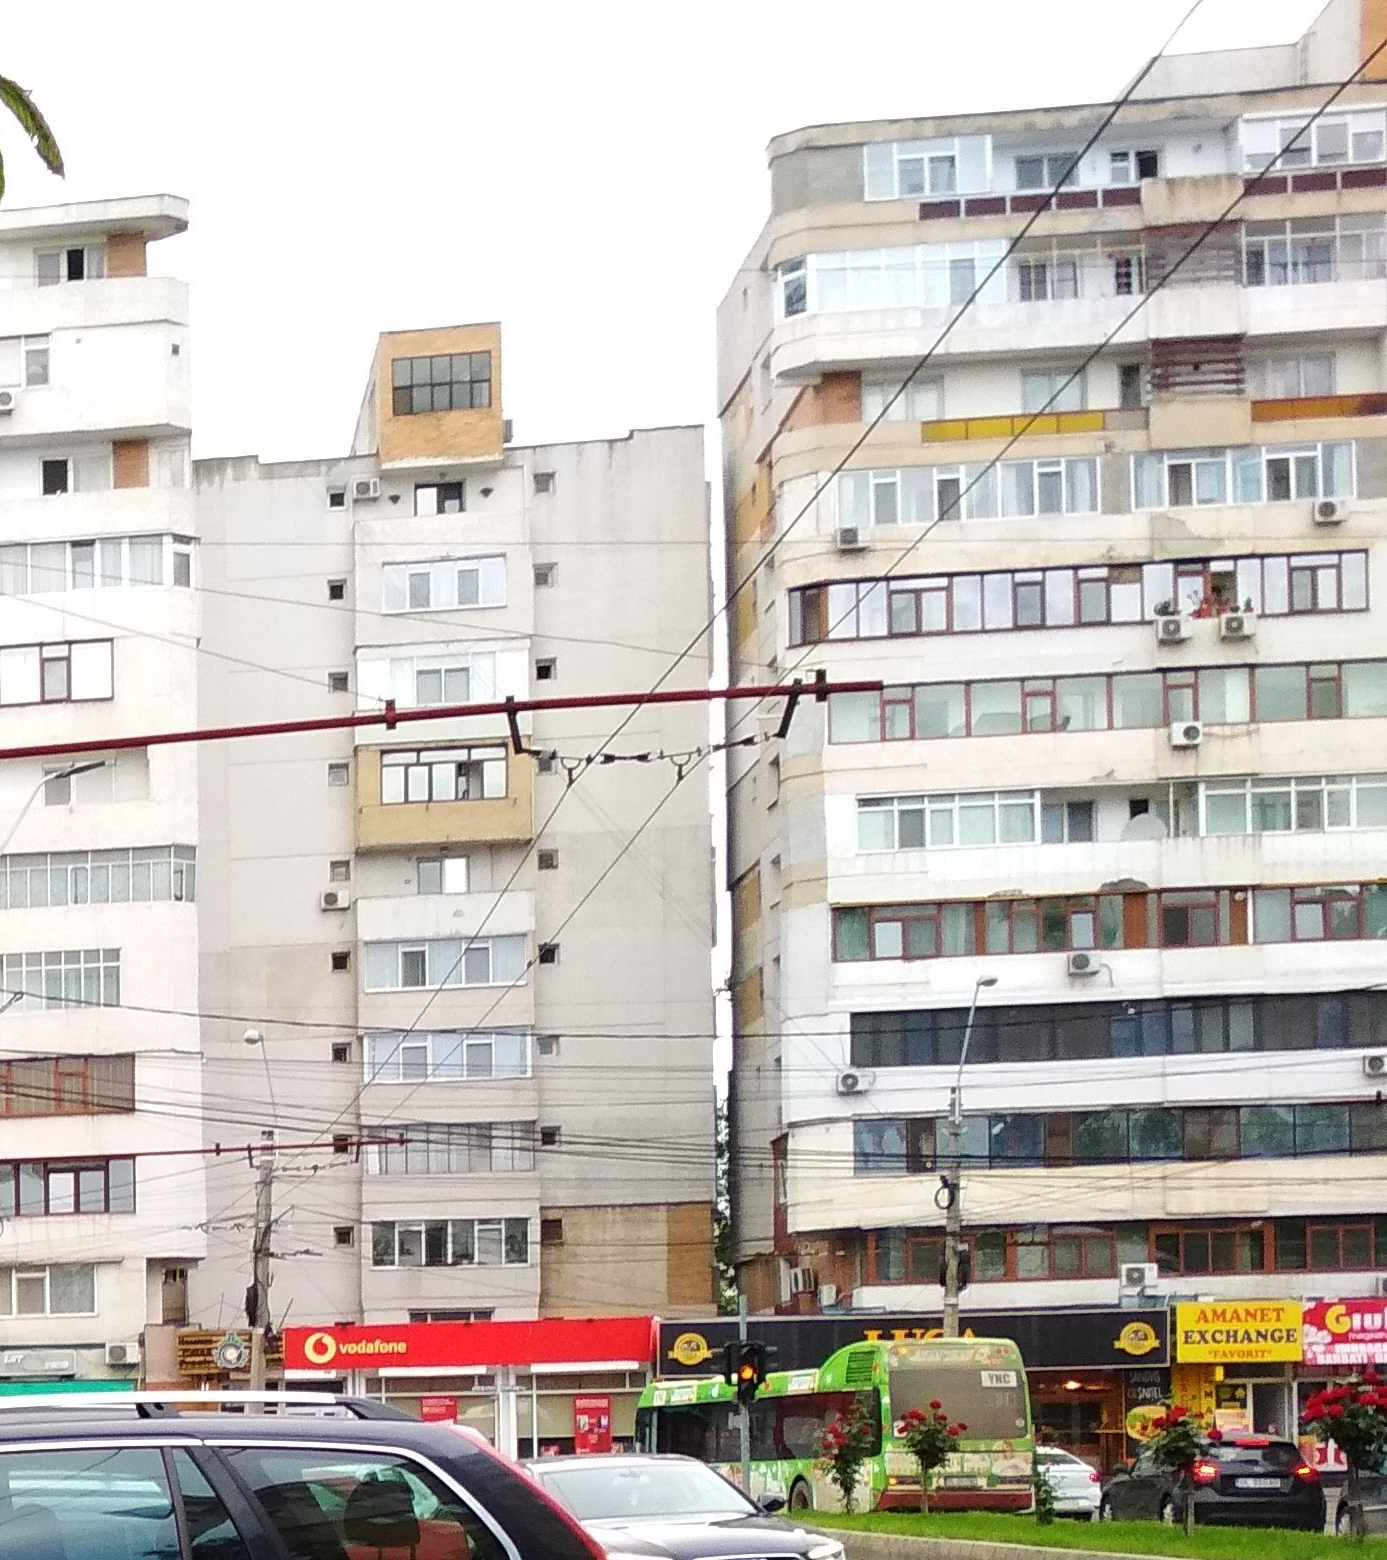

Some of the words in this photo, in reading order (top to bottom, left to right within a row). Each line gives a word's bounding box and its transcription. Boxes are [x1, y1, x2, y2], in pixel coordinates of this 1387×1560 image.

[1195, 1307, 1285, 1324] AMANET
[1182, 1327, 1298, 1345] EXCHANGE
[339, 1339, 407, 1355] vodafone
